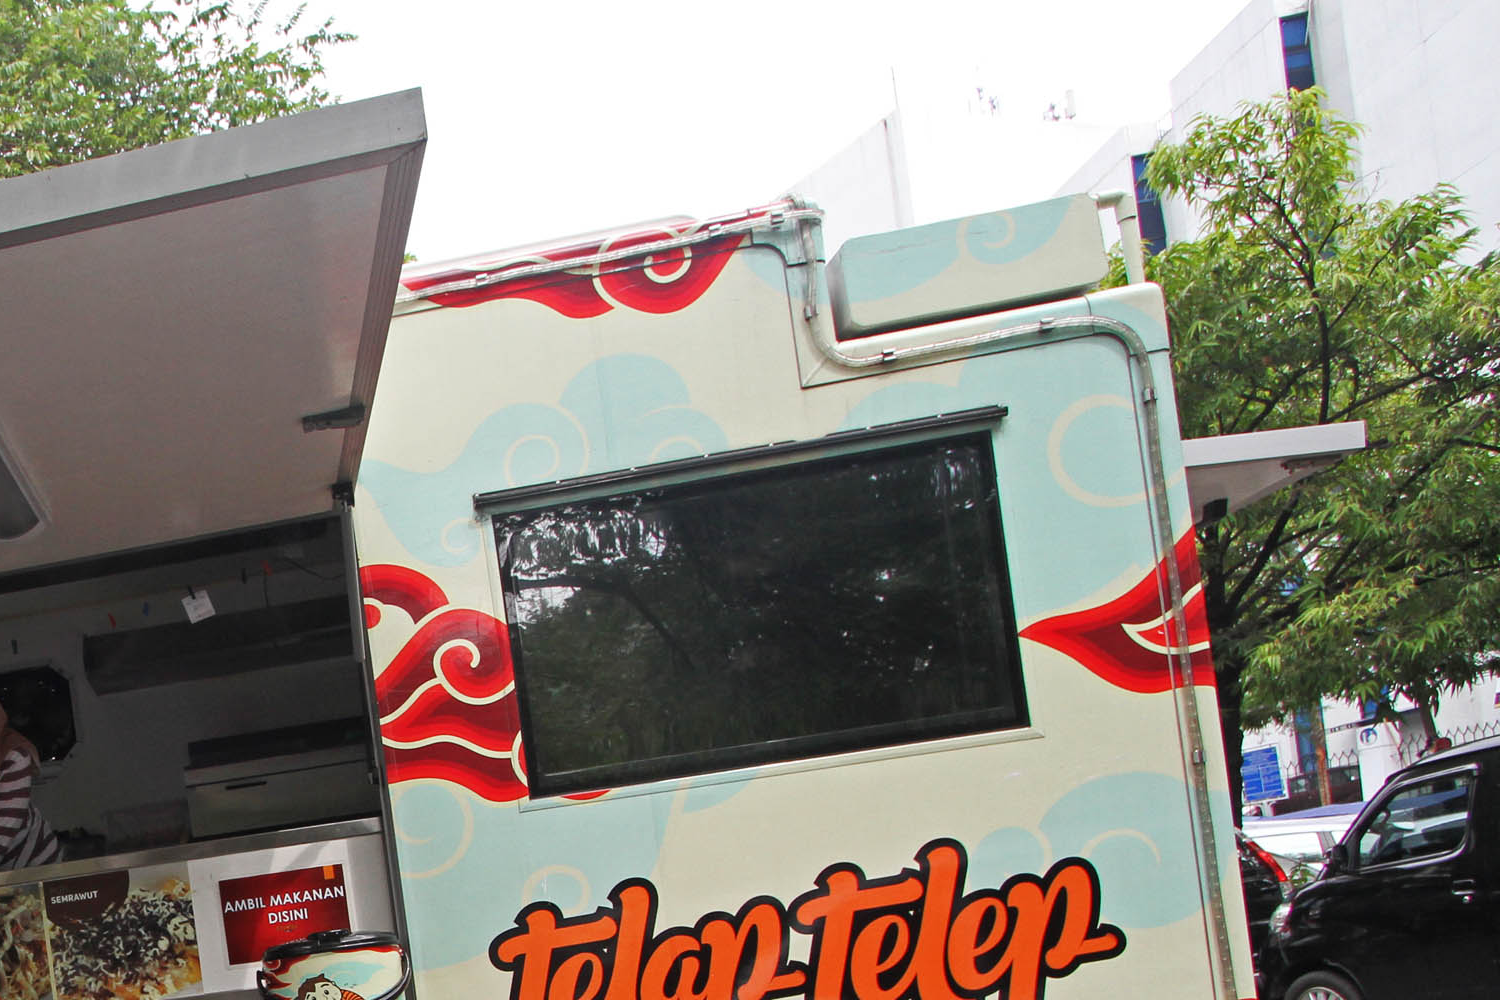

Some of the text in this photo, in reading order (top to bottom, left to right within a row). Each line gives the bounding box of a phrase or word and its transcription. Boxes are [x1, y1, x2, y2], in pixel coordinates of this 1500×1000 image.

[51, 890, 98, 904] SEMRAWUT
[224, 886, 344, 913] AMBIL MAKANAN
[268, 908, 308, 924] DISINI
